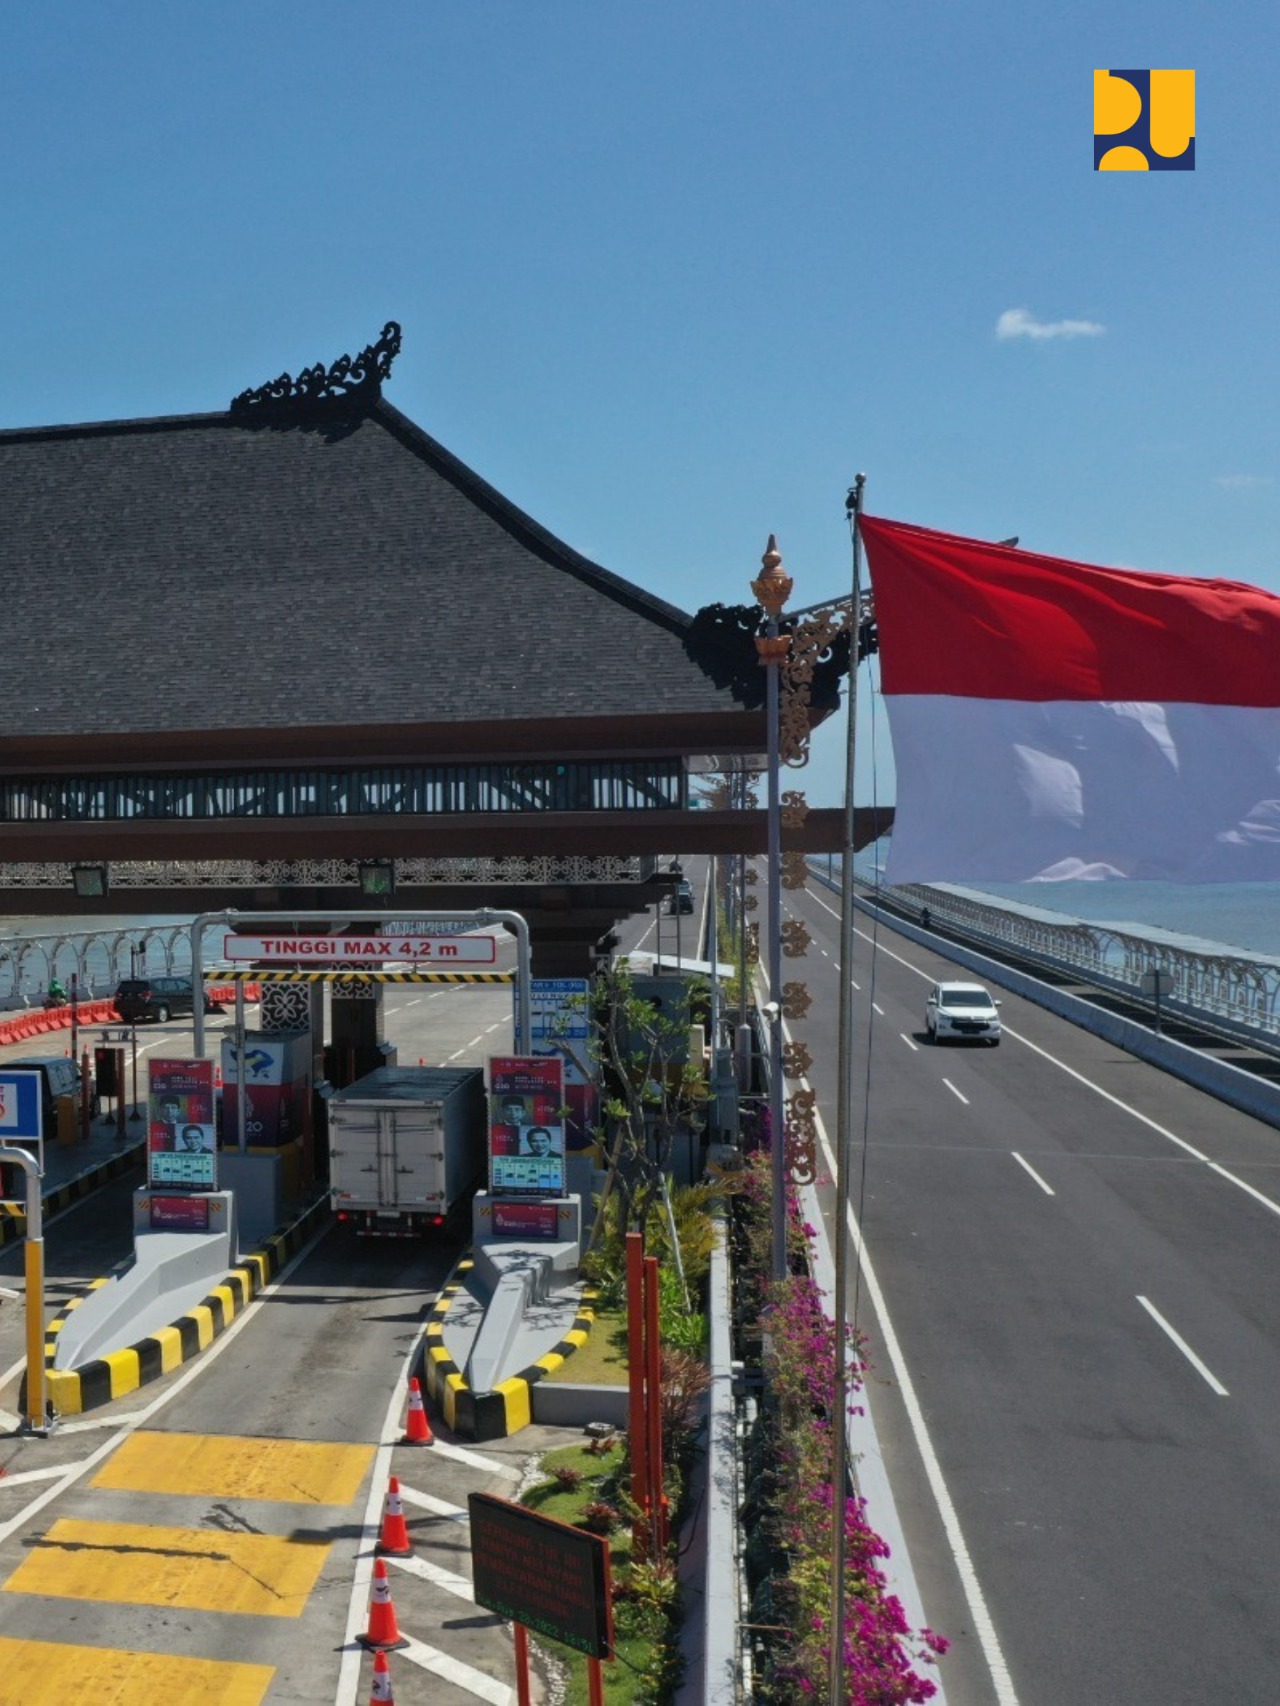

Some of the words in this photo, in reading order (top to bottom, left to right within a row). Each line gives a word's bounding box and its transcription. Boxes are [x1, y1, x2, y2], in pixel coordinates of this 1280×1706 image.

[261, 940, 336, 956] TINGGI
[344, 941, 392, 956] MAX
[398, 942, 431, 959] 4,2
[438, 945, 458, 957] m
